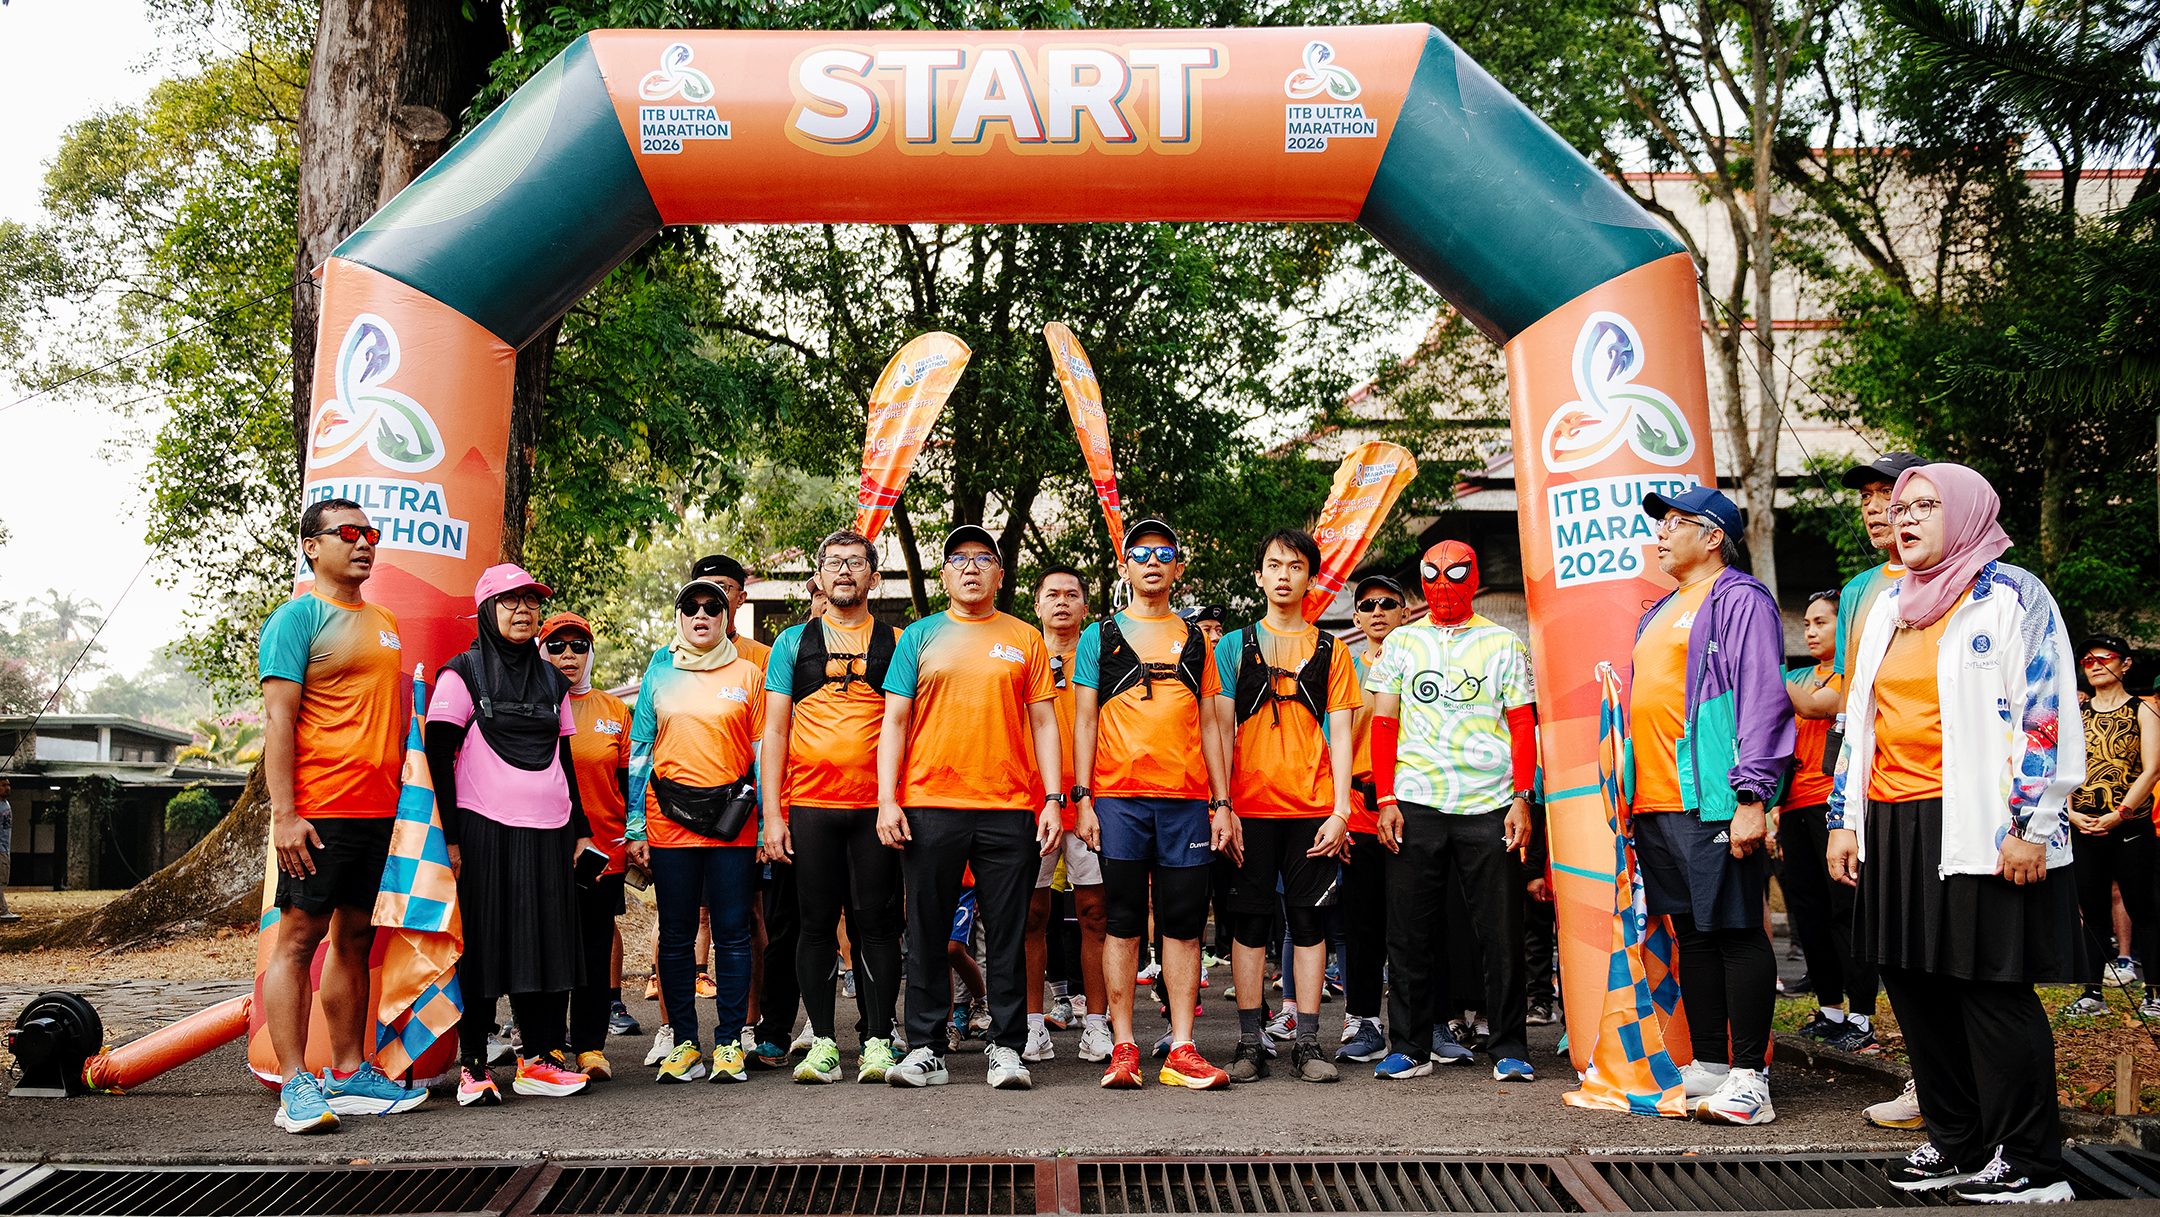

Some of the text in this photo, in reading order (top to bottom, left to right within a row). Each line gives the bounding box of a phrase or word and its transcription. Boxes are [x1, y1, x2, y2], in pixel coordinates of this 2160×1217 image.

[795, 49, 1218, 144] START
[642, 109, 716, 121] ITB ULTRA
[1289, 107, 1363, 119] ITB ULTRA
[643, 124, 728, 136] MARATHON
[1288, 122, 1375, 135] MARATHON
[643, 139, 680, 151] 2026
[1288, 137, 1325, 150] 2026
[1553, 481, 1696, 517] ITB ULTR
[371, 516, 463, 551] THON
[1556, 513, 1652, 548] MARA
[1560, 547, 1637, 580] 2026
